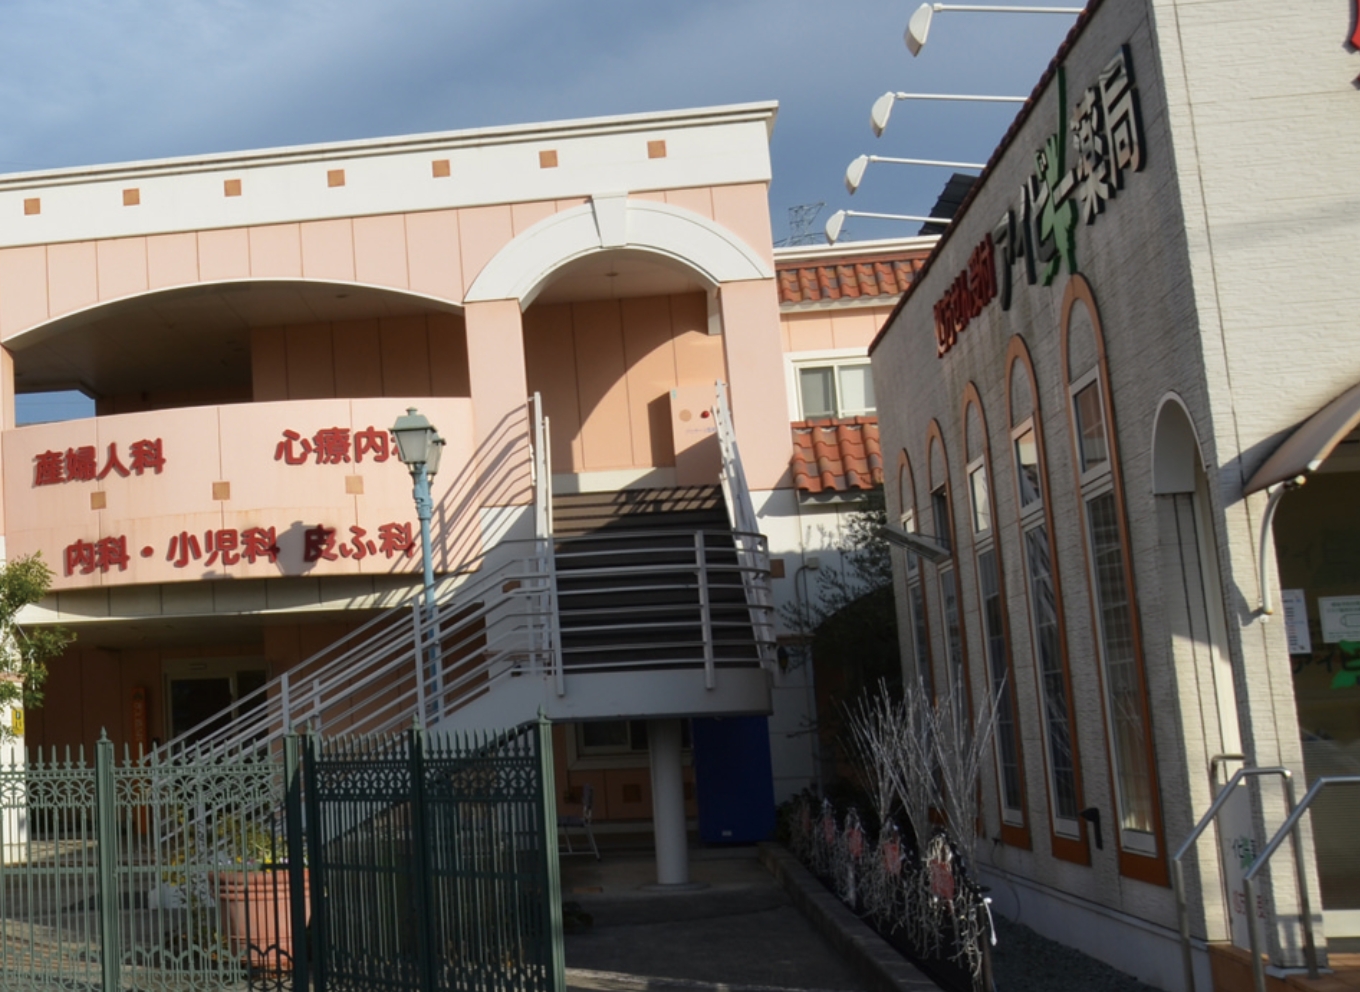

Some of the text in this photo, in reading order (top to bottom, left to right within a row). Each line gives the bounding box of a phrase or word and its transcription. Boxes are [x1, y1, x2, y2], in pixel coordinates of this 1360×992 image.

[993, 44, 1146, 311] アイビー薬局
[33, 437, 167, 487] 産婦人科
[274, 425, 401, 465] 心療内
[65, 522, 416, 576] 内科・小児科 皮ふ科
